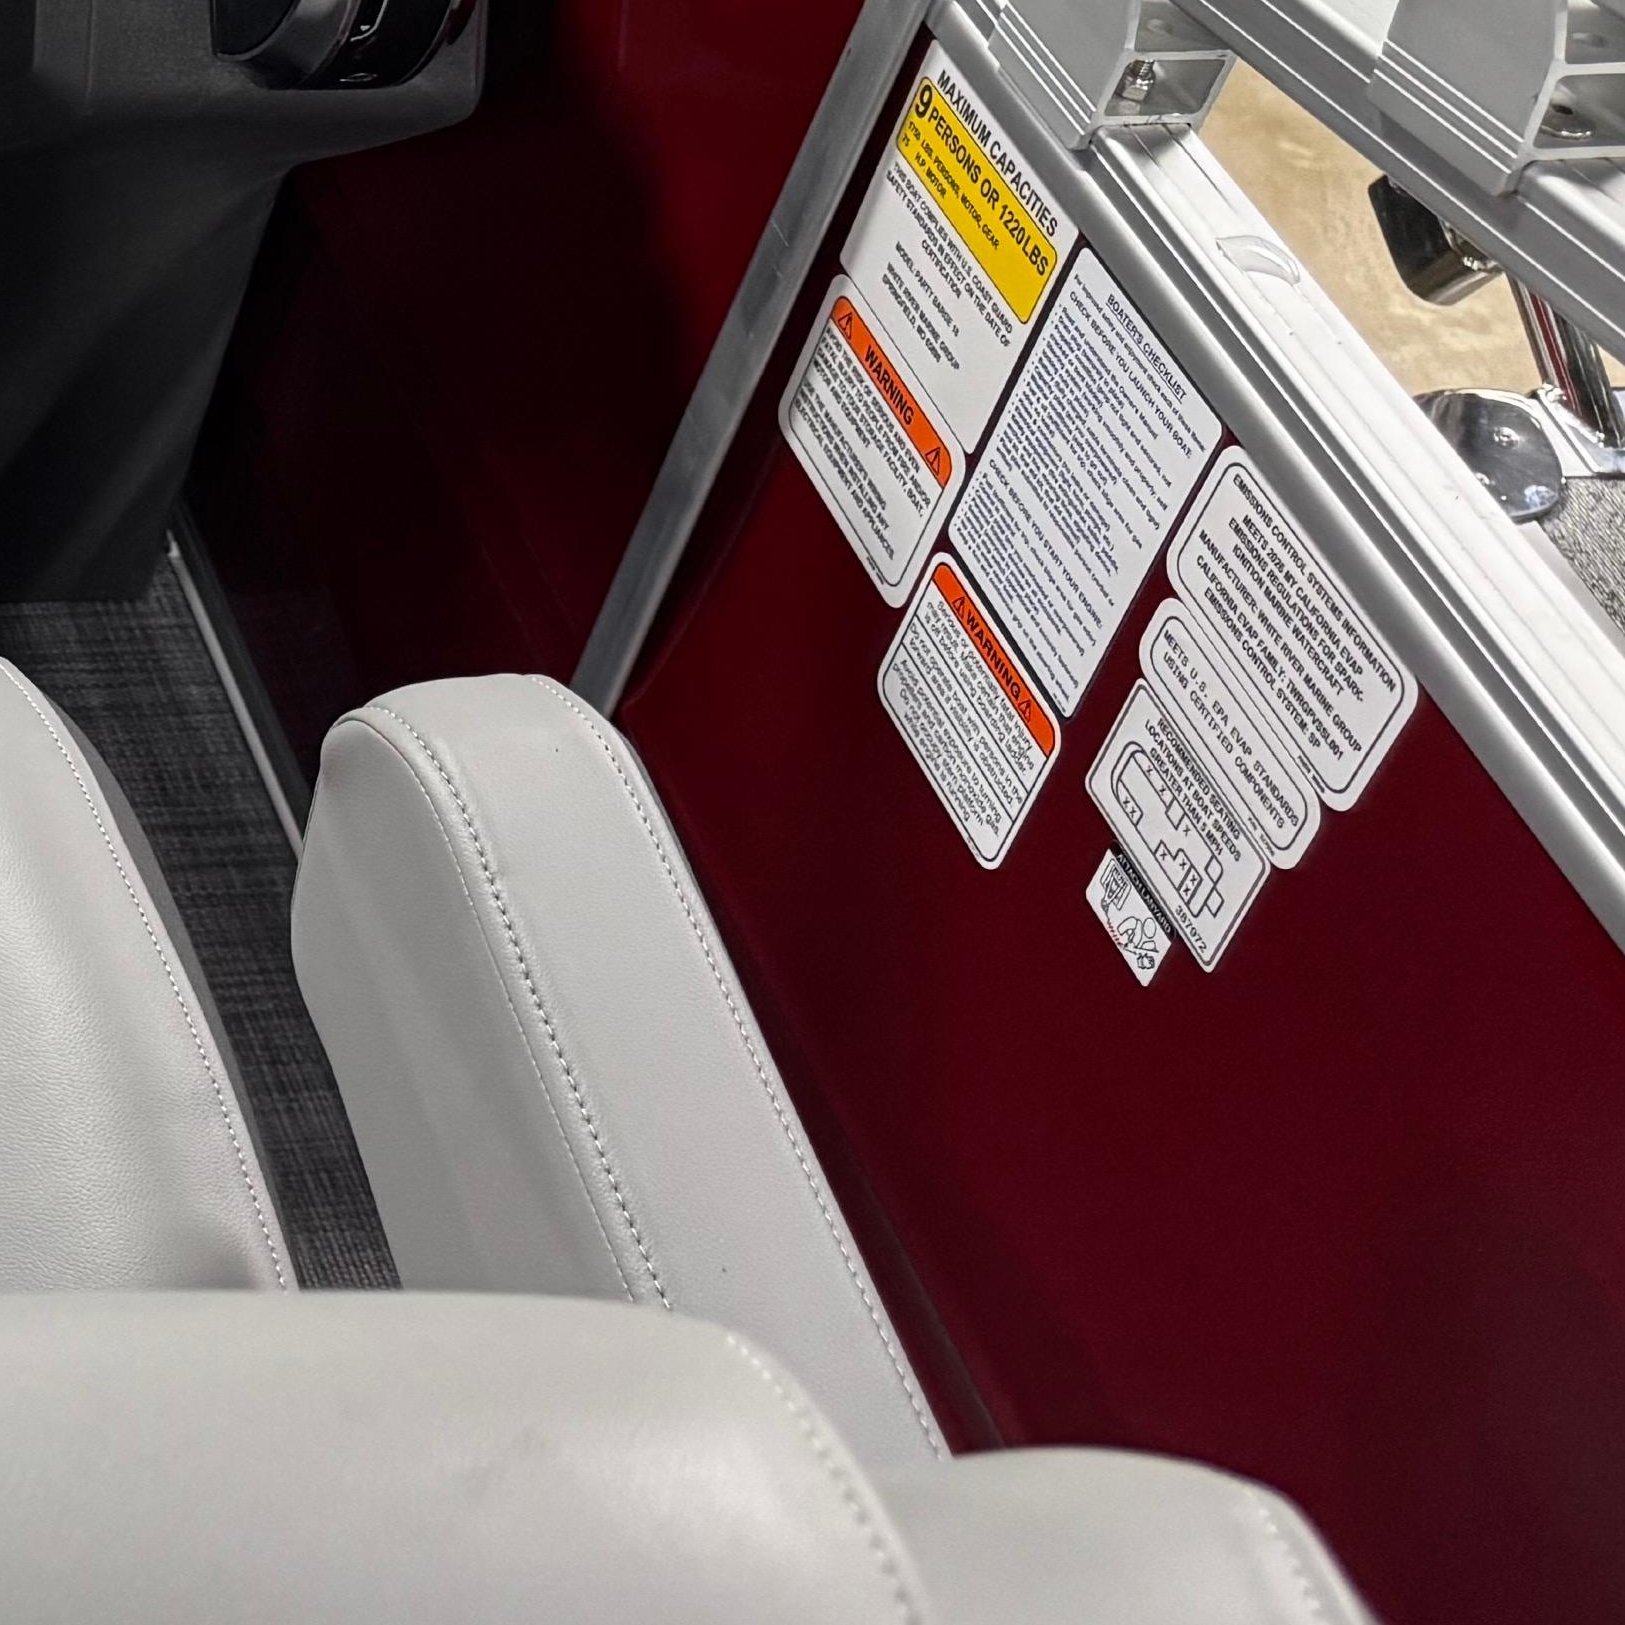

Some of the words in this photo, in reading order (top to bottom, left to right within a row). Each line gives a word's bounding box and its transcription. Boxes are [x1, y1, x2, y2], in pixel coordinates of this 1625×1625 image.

[914, 83, 933, 119] 9
[927, 105, 981, 184] PERSONS
[979, 177, 1000, 210] OR
[998, 203, 1026, 245] 1220
[1021, 234, 1049, 276] LBS
[936, 69, 992, 148] MAXIMUM
[989, 140, 1058, 237] CAPACITIES
[864, 345, 914, 425] WARNING
[1105, 293, 1144, 349] BOATER'S
[1139, 342, 1187, 404] CHECKLIST
[1196, 554, 1238, 615] CALIFORNIA
[1236, 611, 1259, 639] EVAP
[1203, 586, 1243, 642] EMISSIONS
[1241, 639, 1276, 691] CONTROL
[1227, 516, 1269, 572] EMISSIONS
[1265, 568, 1320, 641] REGULATIONS
[1316, 637, 1336, 665] FOR
[1231, 543, 1266, 590] IGNITION
[1262, 585, 1294, 628] MARINE
[1291, 623, 1344, 696] WATERCRAFT
[1232, 472, 1273, 528] EMISSIONS
[1270, 524, 1307, 576] CONTROL
[1306, 571, 1344, 622] SYSTEMS
[1340, 617, 1396, 692] INFORMATION
[1241, 514, 1269, 551] MEETS
[1282, 569, 1298, 588] MY
[1295, 586, 1341, 650] CALIFORNIA
[1338, 645, 1363, 675] EVAP
[966, 610, 1021, 701] WARNING
[1163, 628, 1189, 667] MEETS
[1211, 699, 1228, 727] EPA
[1229, 726, 1252, 756] EVAP
[1252, 759, 1299, 827] STANDARDS
[1256, 608, 1283, 646] WHITE
[1279, 641, 1305, 677] RIVER
[1302, 672, 1334, 717] MARINE
[1331, 713, 1362, 752] GROUP
[1144, 718, 1184, 778] LOCATIONS
[1191, 788, 1214, 820] BOAT
[1211, 818, 1241, 862] SPEEDS
[1149, 747, 1183, 797] GREATER
[1181, 792, 1202, 825] THAN
[1204, 829, 1223, 856] MPH
[1156, 717, 1210, 796] RECOMMENDED
[1208, 793, 1240, 840] SEATING
[1162, 651, 1189, 690] USING
[1189, 689, 1233, 754] CERTIFIED
[1234, 755, 1285, 829] COMPONENTS
